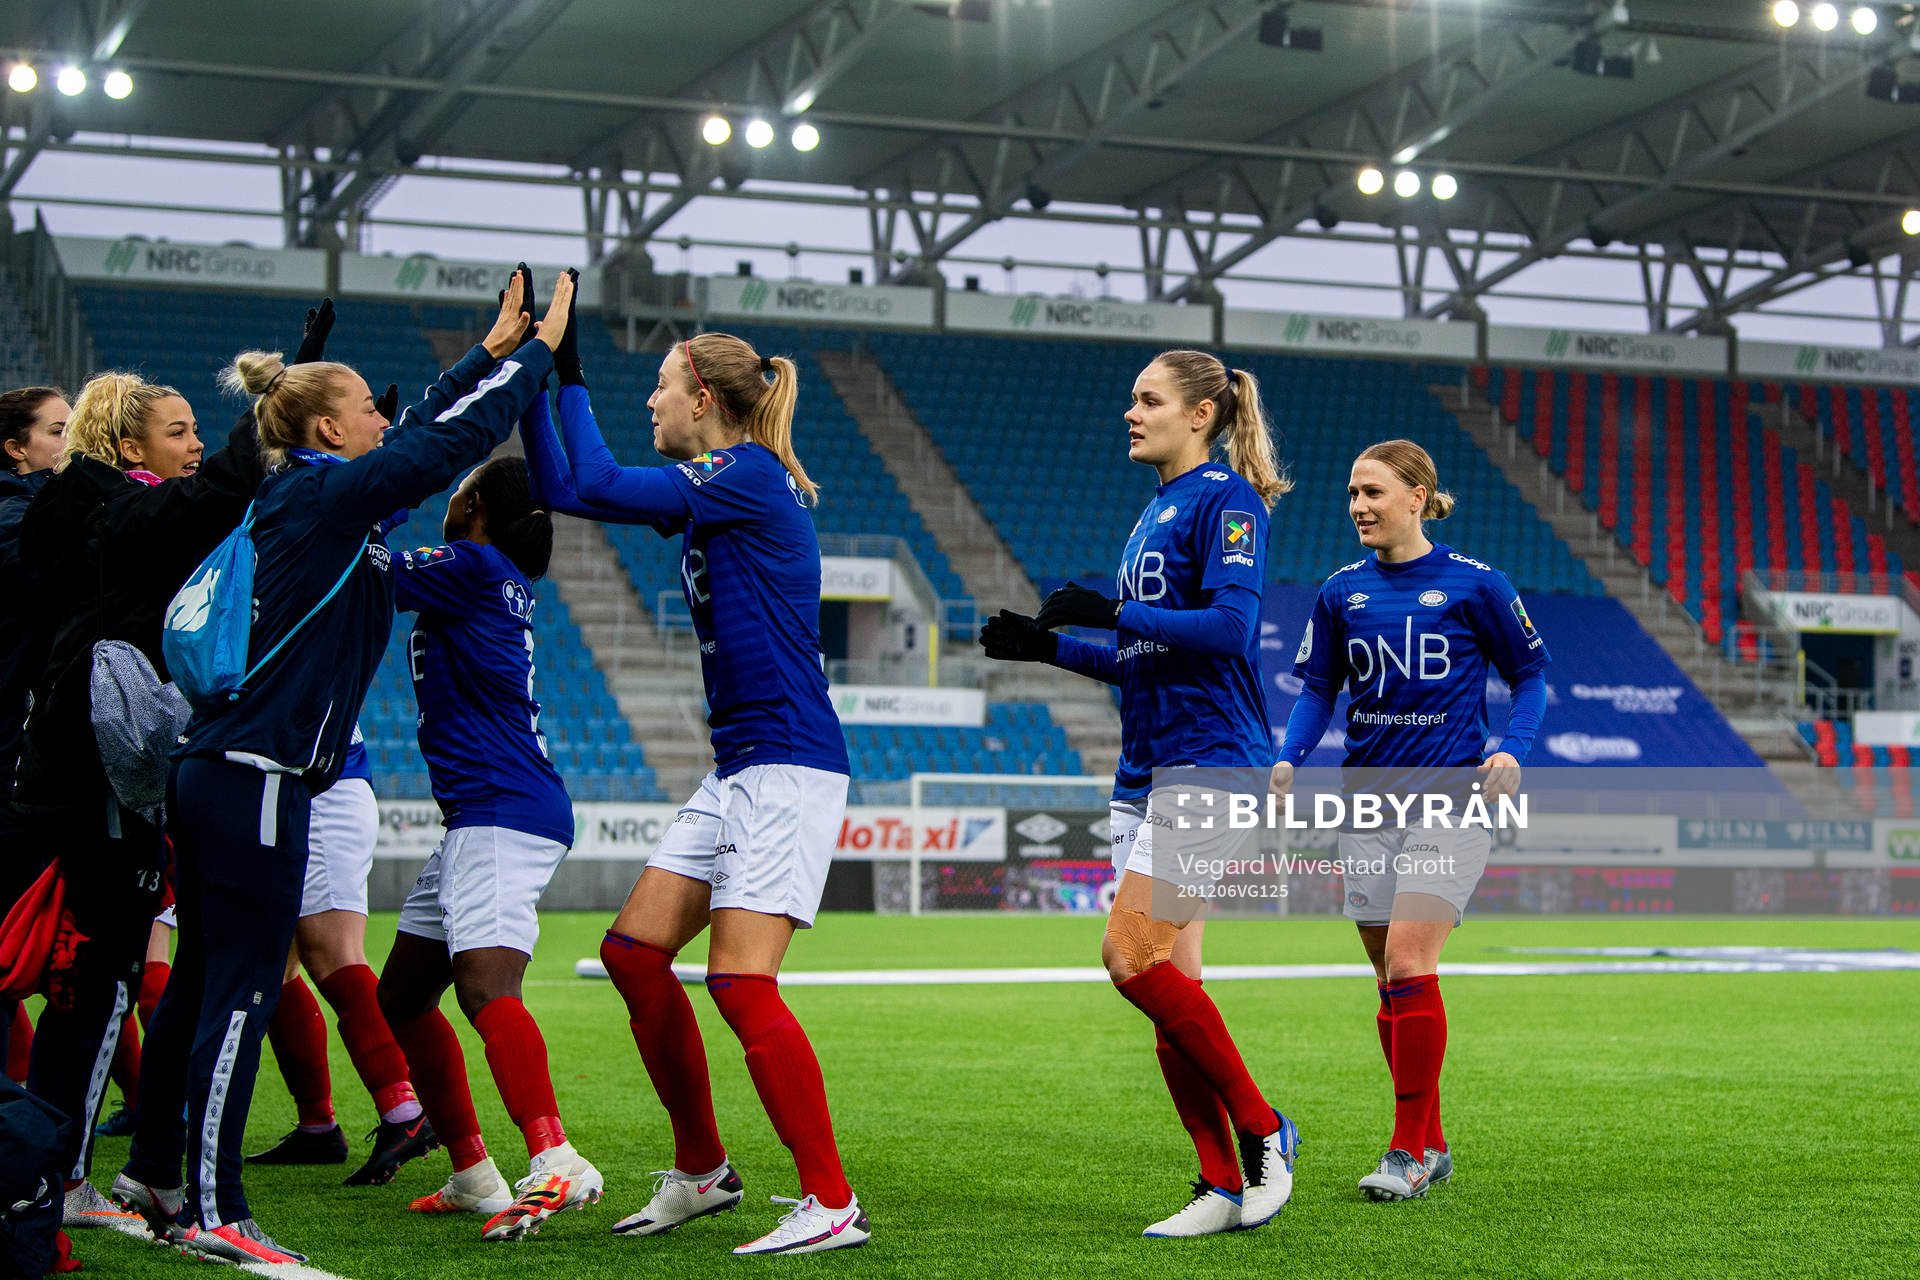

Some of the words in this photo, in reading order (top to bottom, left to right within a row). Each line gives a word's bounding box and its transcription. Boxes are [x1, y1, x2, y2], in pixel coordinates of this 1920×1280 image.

[147, 249, 201, 273] NRC
[205, 250, 276, 278] Group
[436, 266, 489, 290] NRC
[776, 287, 825, 311] NRC
[829, 288, 892, 316] Group
[1045, 303, 1093, 326] NRC
[1096, 305, 1155, 330] Group
[1317, 320, 1361, 342] NRC
[1365, 322, 1422, 348] Group
[1577, 335, 1618, 359] NRC
[1622, 337, 1675, 362] Group
[1824, 350, 1866, 373] NRC
[367, 544, 391, 564] THON
[1222, 553, 1254, 567] umbro
[1448, 553, 1491, 571] coop
[1796, 601, 1834, 618] NRC
[1348, 615, 1450, 698] DNB
[864, 695, 900, 712] NRC
[1352, 708, 1447, 726] #huninvesterer
[685, 813, 699, 824] Bil
[598, 817, 661, 845] NRC
[837, 816, 959, 850] loTaxi
